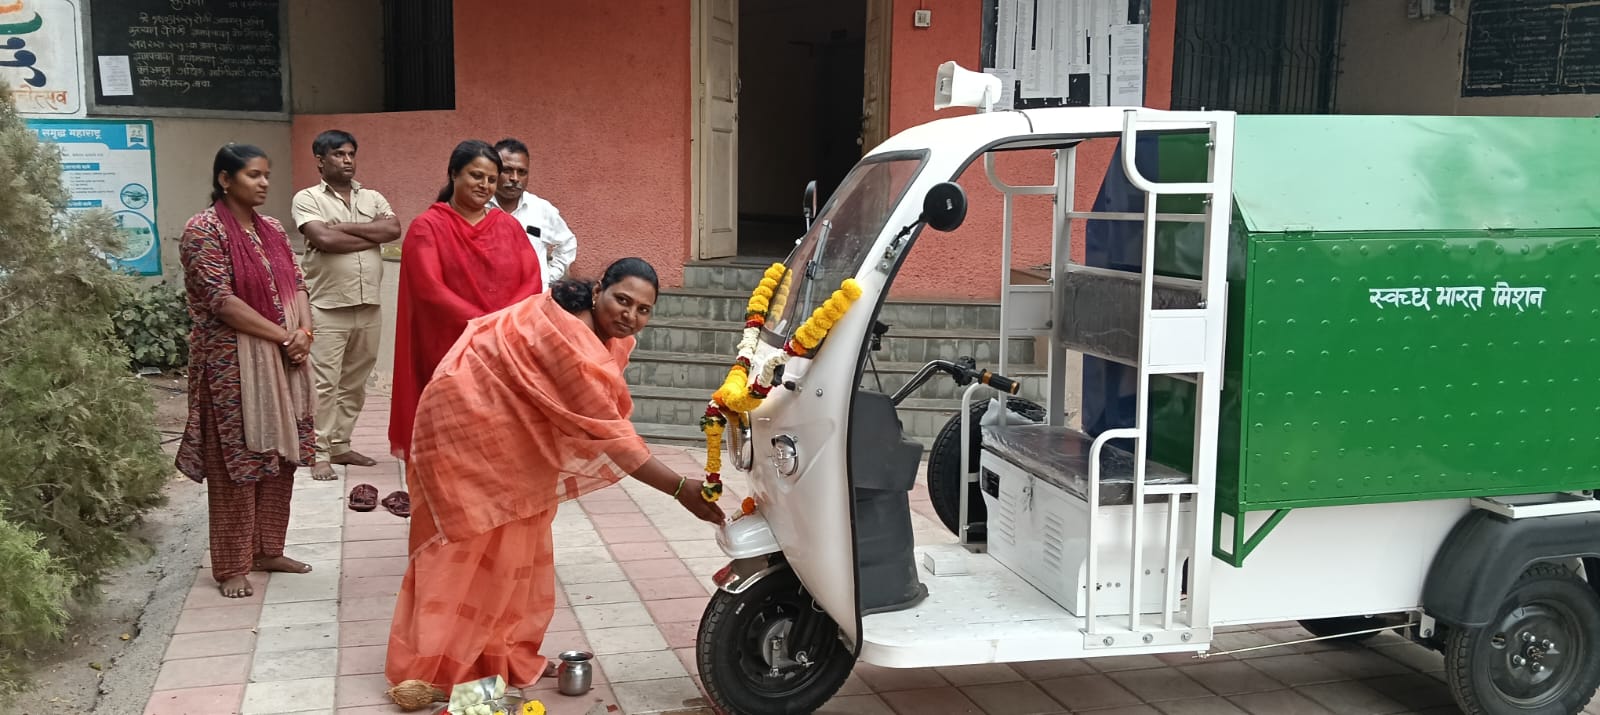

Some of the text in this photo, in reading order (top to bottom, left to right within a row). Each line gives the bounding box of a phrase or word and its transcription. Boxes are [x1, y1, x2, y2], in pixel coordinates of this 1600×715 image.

[68, 128, 102, 140] महाराष्ट्र
[1436, 286, 1486, 312] भारत
[1491, 281, 1547, 313] मिशन
